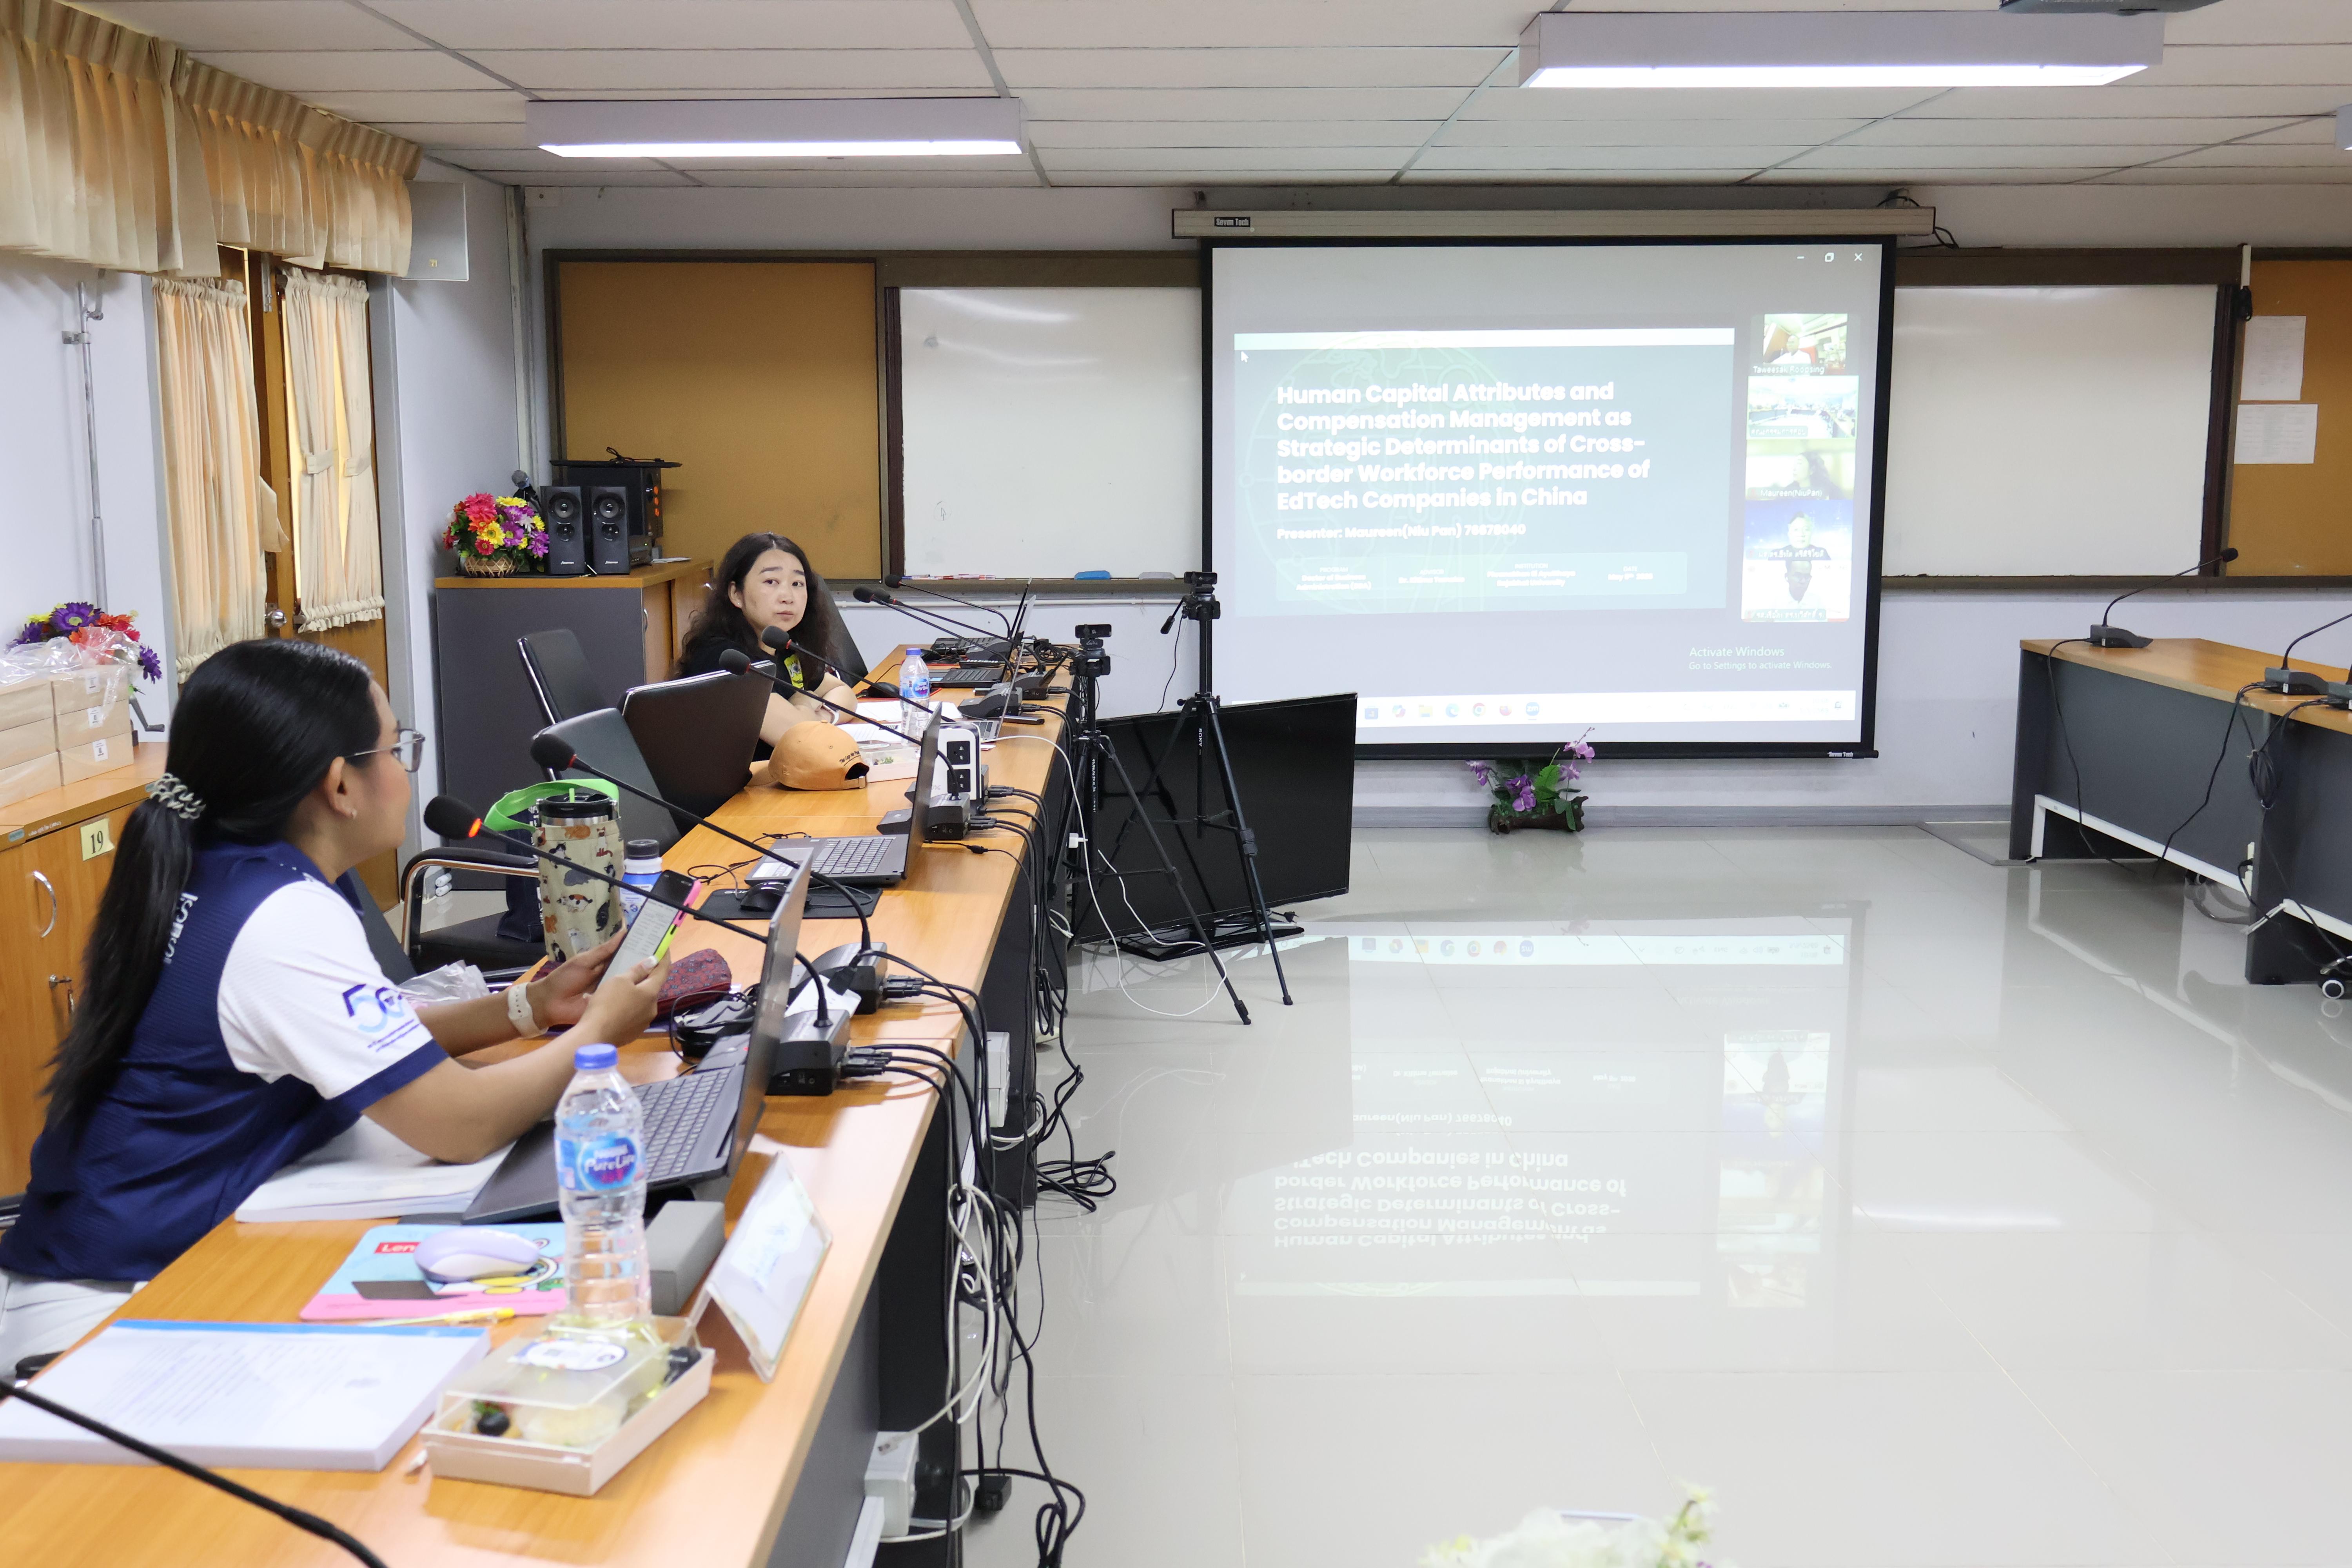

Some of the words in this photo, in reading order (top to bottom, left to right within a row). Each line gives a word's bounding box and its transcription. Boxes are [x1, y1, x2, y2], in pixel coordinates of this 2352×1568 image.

[1277, 387, 1361, 404] Human
[1365, 383, 1448, 408] Capital
[1452, 382, 1566, 401] Attributes
[1570, 382, 1614, 400] and
[1277, 409, 1444, 435] Compensation
[1449, 408, 1601, 432] Management
[1604, 411, 1632, 426] as
[1277, 436, 1381, 462] Strategic
[1385, 435, 1540, 455] Determinants
[1544, 434, 1566, 453] of
[1570, 435, 1645, 452] Cross-
[1277, 465, 1353, 483] border
[1357, 462, 1474, 482] Workforce
[1479, 460, 1624, 480] Performance
[1628, 459, 1650, 478] of
[1277, 490, 1358, 510] EdTech
[1363, 487, 1491, 513] Companies
[1496, 486, 1517, 506] in
[1521, 486, 1587, 505] China
[1277, 528, 1343, 539] Presenter:
[1345, 524, 1429, 539] Maureen(Niu
[1432, 523, 1462, 538] Pan)
[1464, 524, 1526, 535] 76678040
[1690, 646, 1732, 657] Activate
[1735, 646, 1785, 657] Windows
[1714, 662, 1746, 671] Settings
[1793, 661, 1831, 669] Windows.
[91, 830, 103, 854] 19
[382, 1244, 415, 1252] Len
